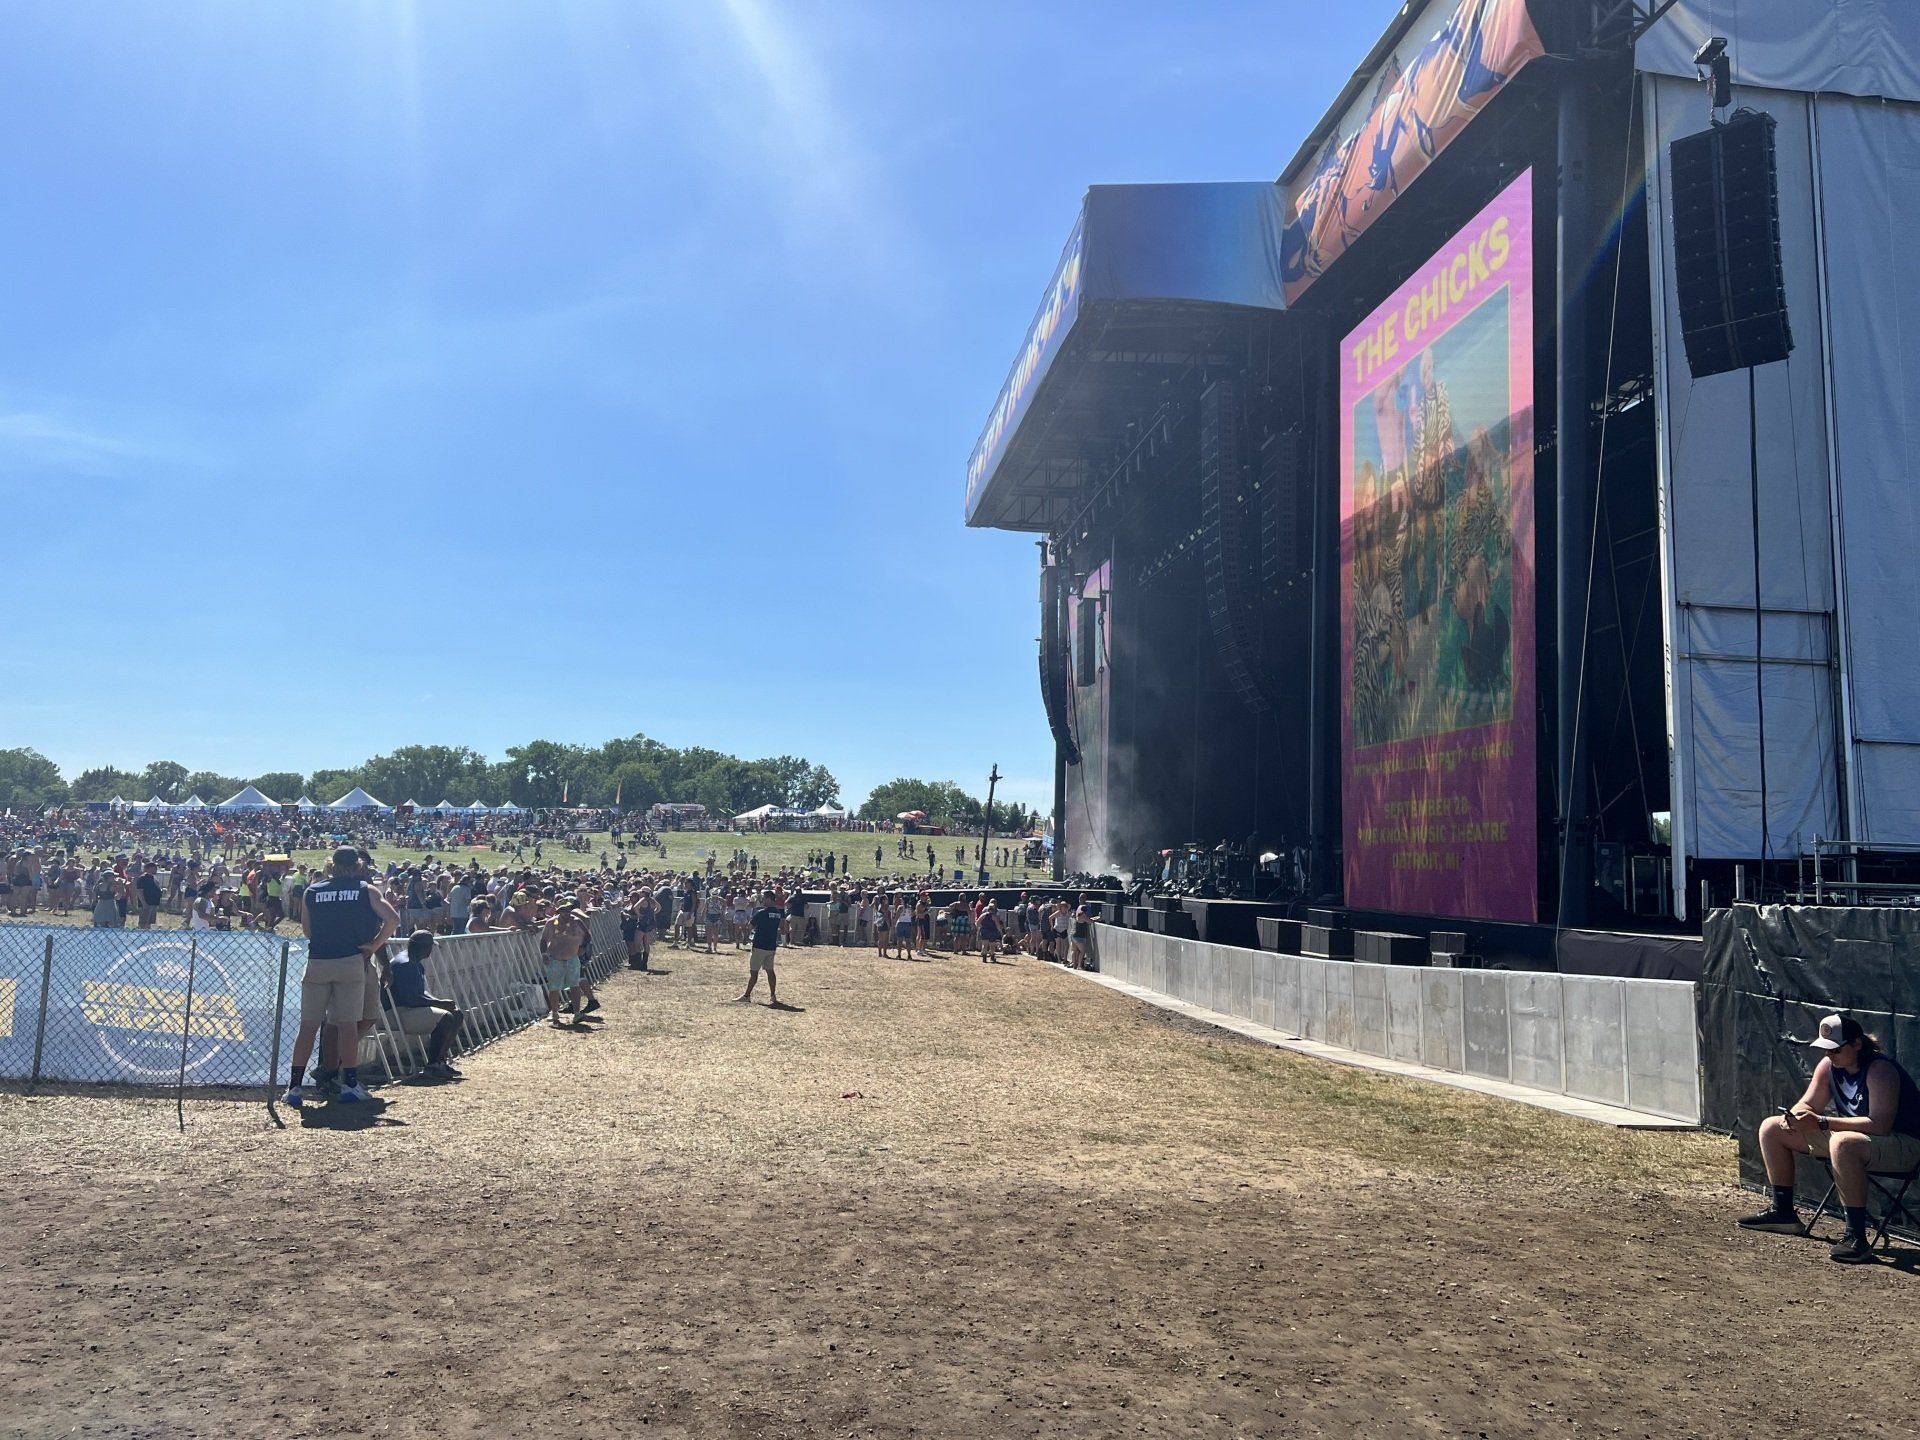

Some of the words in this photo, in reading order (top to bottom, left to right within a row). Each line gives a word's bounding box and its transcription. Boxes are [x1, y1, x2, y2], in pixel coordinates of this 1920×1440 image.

[1353, 312, 1400, 384] THE
[1404, 216, 1510, 342] CHICKS
[1384, 799, 1451, 819] SEPTEMBER
[1410, 824, 1446, 844] MUSIC
[1450, 821, 1509, 843] THEATRE
[315, 891, 337, 903] EVENT
[338, 889, 360, 901] STAFF
